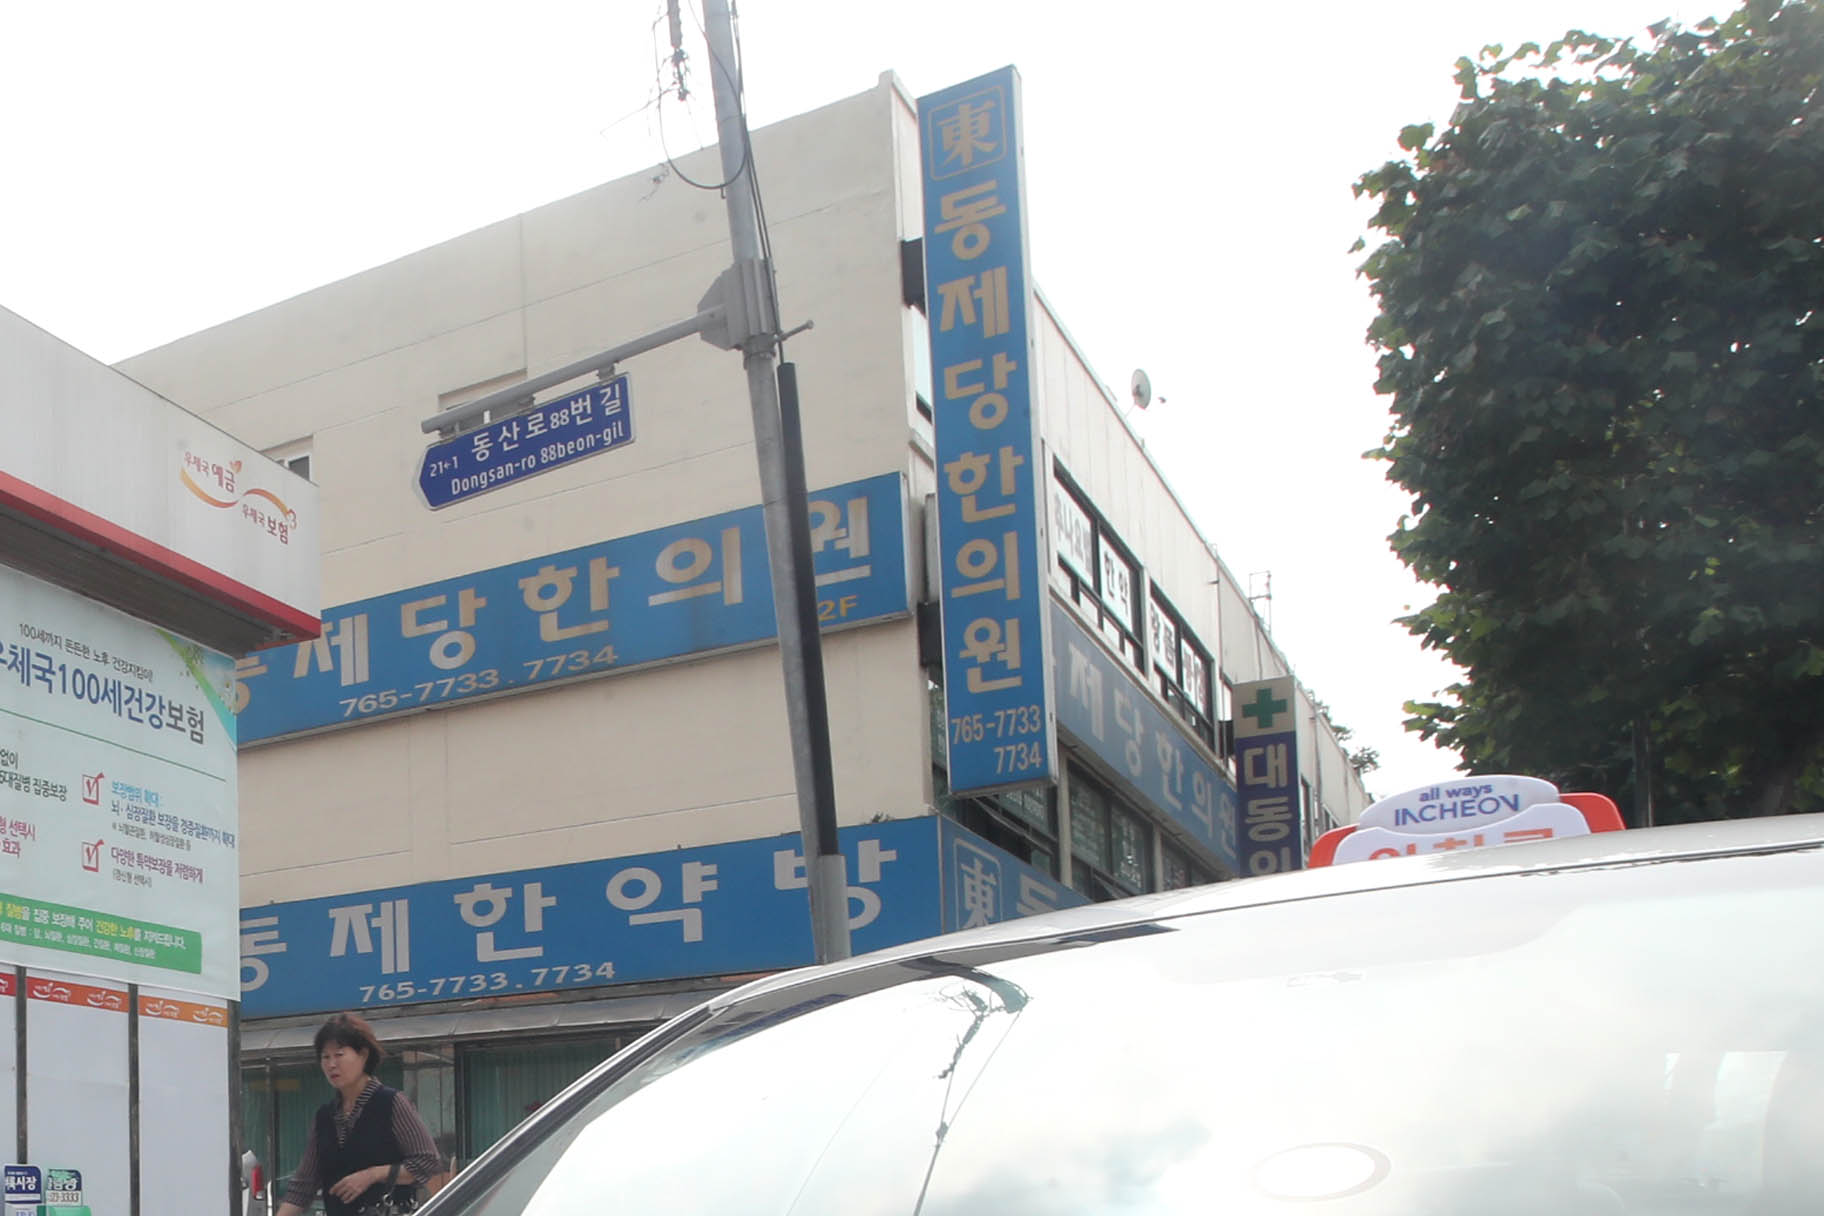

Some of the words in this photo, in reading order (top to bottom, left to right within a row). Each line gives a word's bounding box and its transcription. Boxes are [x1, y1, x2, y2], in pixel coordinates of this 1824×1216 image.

[937, 101, 998, 168] 東
[934, 179, 1024, 694] 동제당한의원
[185, 451, 209, 477] 우체국
[212, 464, 235, 493] 예금
[451, 455, 536, 495] Dongsan-ro
[541, 421, 623, 464] 88beon-gil
[242, 504, 265, 527] 우체국
[267, 516, 288, 544] 보험
[19, 623, 63, 650] 100세까지
[93, 649, 111, 667] 노후
[951, 704, 1041, 745] 765-7733
[994, 741, 1042, 775] 7734
[1052, 640, 1237, 860] 제당한의원
[1394, 794, 1520, 827] INCHEON
[1419, 787, 1440, 802] all
[1445, 784, 1493, 800] ways
[3, 839, 21, 858] 효과
[9, 820, 36, 841] 선택시
[111, 846, 135, 867] 다양한
